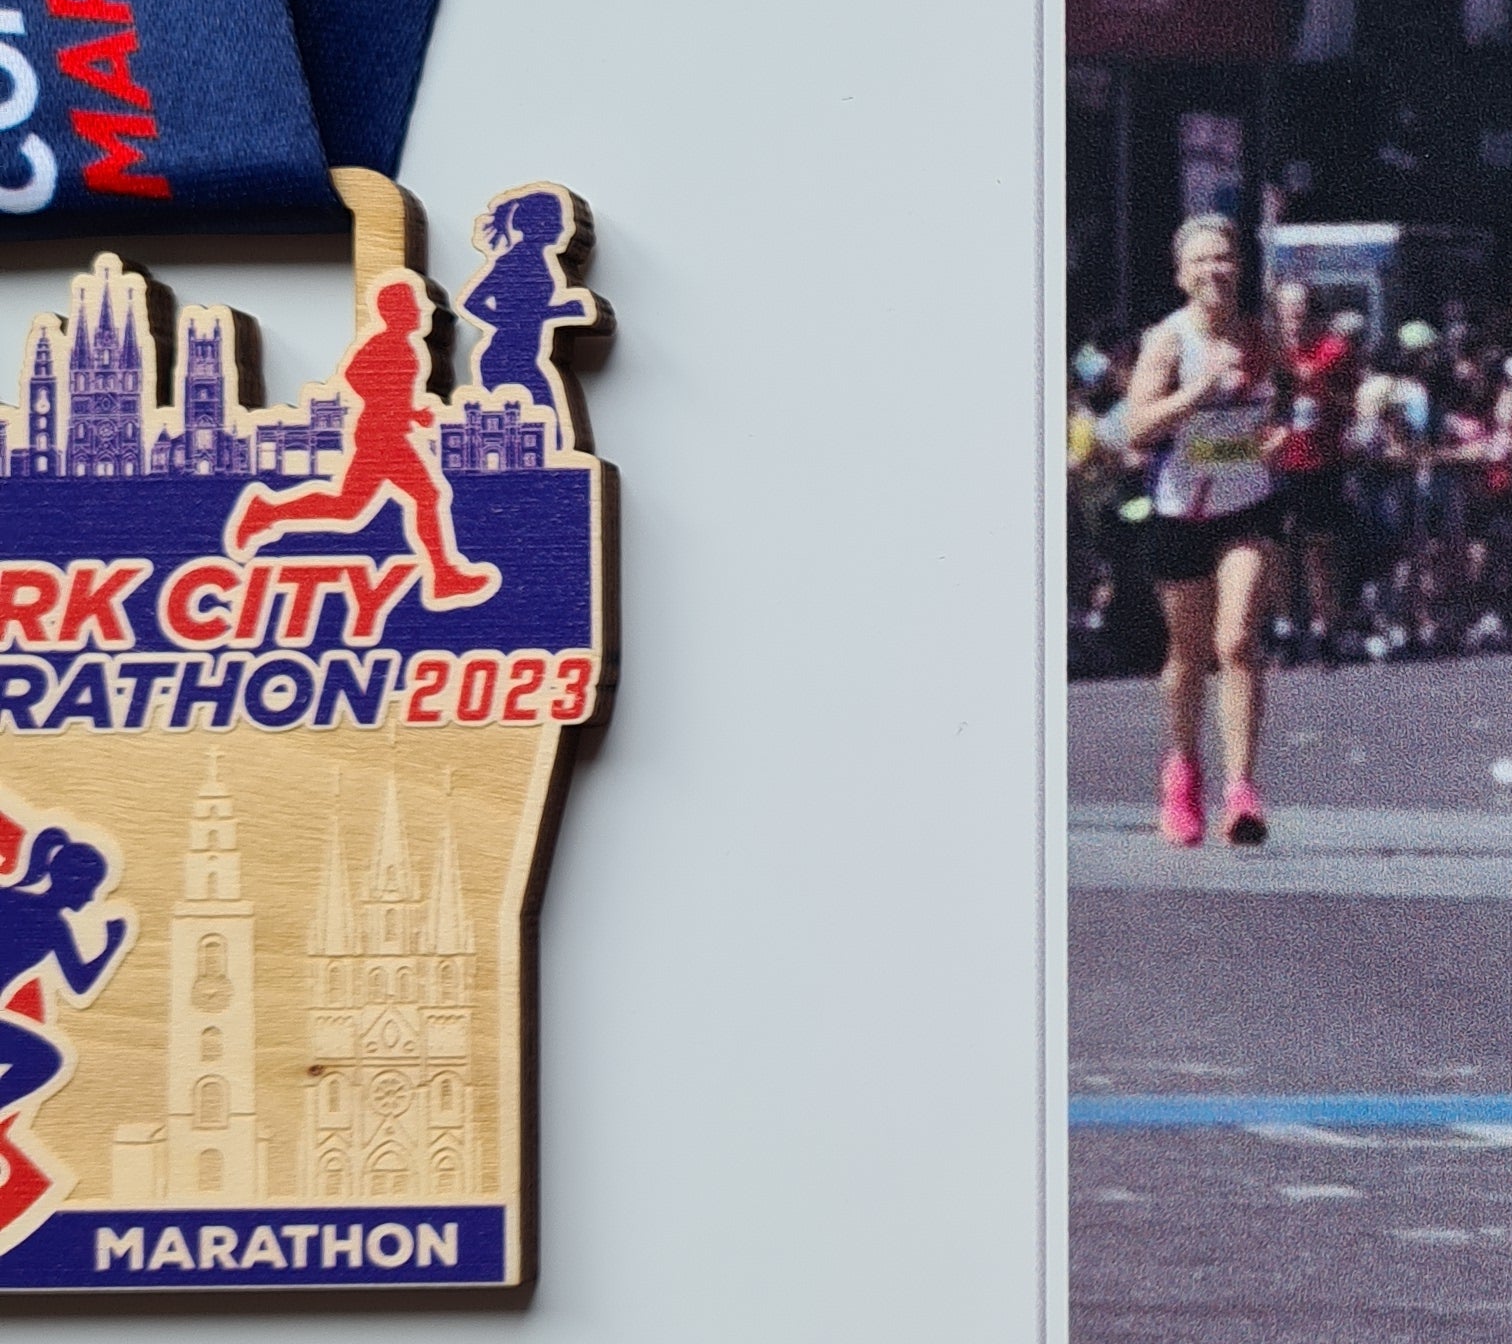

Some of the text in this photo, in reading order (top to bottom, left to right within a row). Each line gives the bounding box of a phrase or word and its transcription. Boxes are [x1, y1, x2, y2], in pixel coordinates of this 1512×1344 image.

[0, 563, 421, 643] RK CITY
[0, 658, 593, 729] RATHON 2023
[95, 1221, 459, 1272] MARATHON
